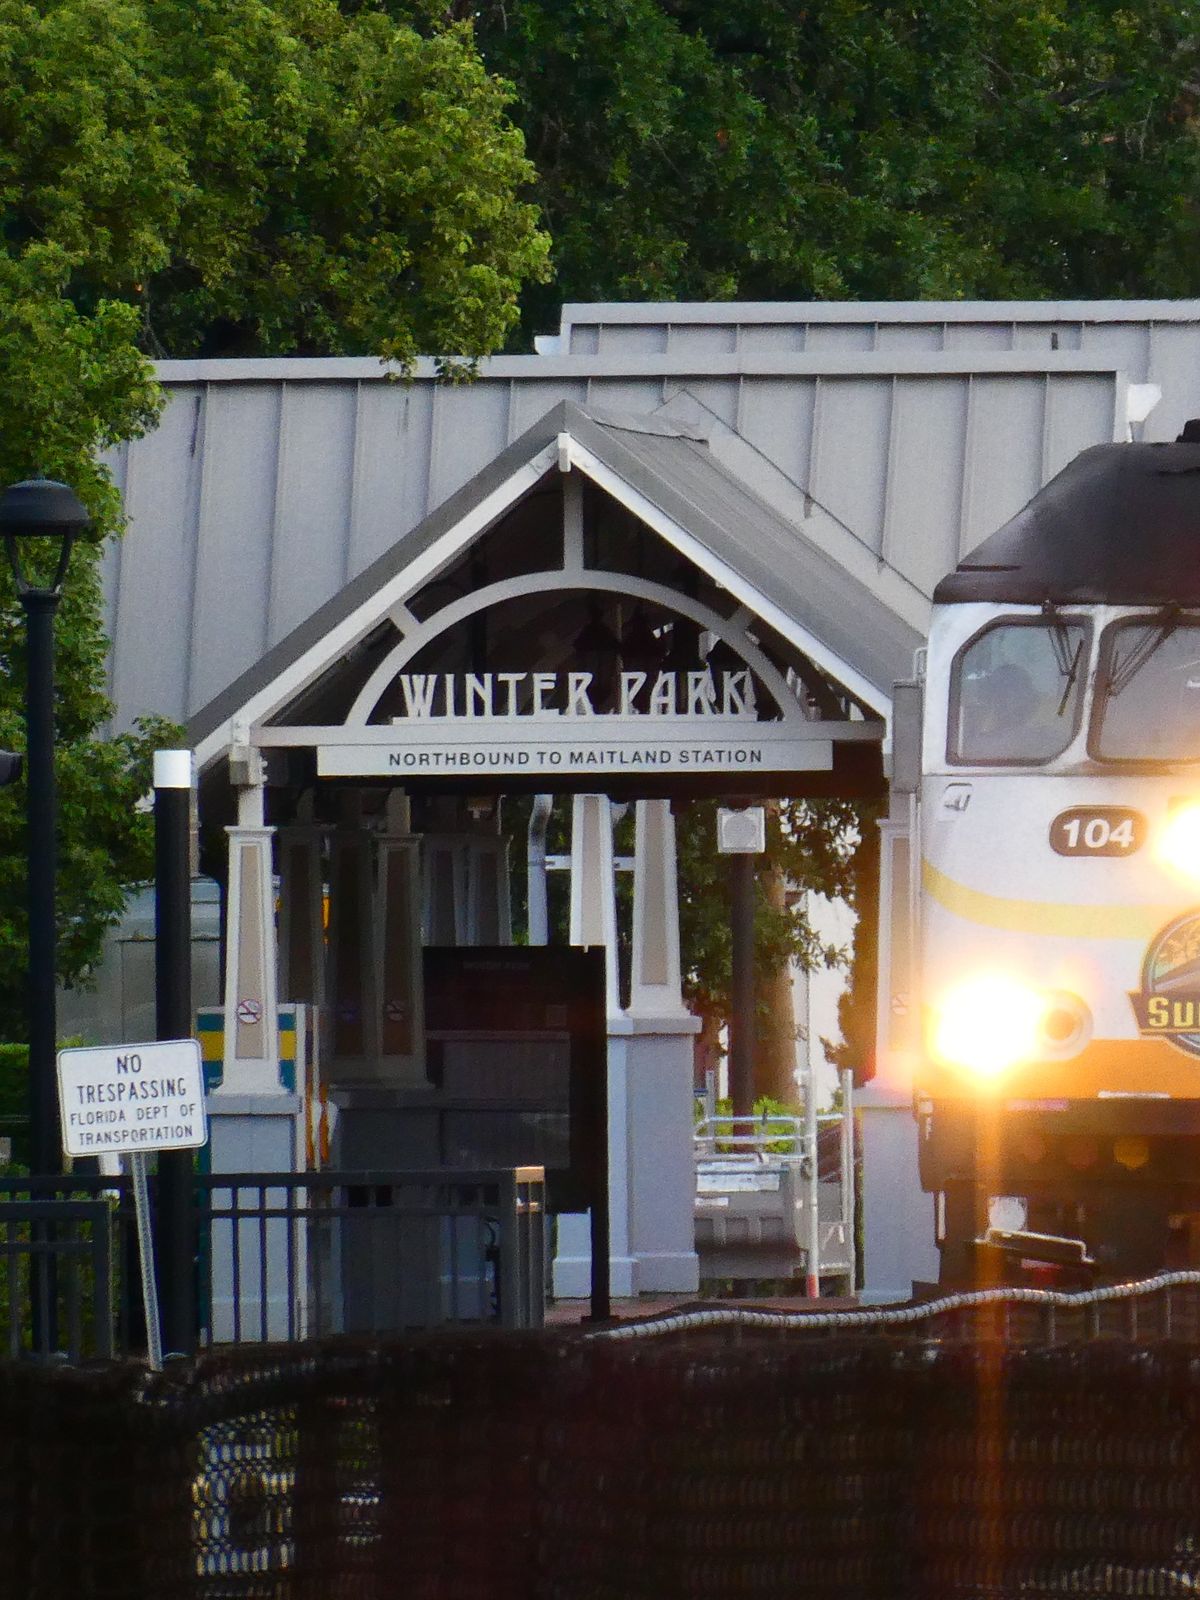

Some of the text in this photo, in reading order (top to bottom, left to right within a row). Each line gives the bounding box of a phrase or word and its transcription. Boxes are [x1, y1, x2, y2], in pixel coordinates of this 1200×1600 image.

[400, 670, 755, 716] WINTER PARK
[388, 749, 763, 767] NORTHBOUND TO MAITLAND STATION
[1062, 818, 1135, 849] 104
[116, 1054, 142, 1074] NO
[76, 1077, 187, 1105] TRESPASSING
[70, 1103, 197, 1126] FLORIDA DEPT OF
[79, 1125, 194, 1146] TRANSPORTATION
